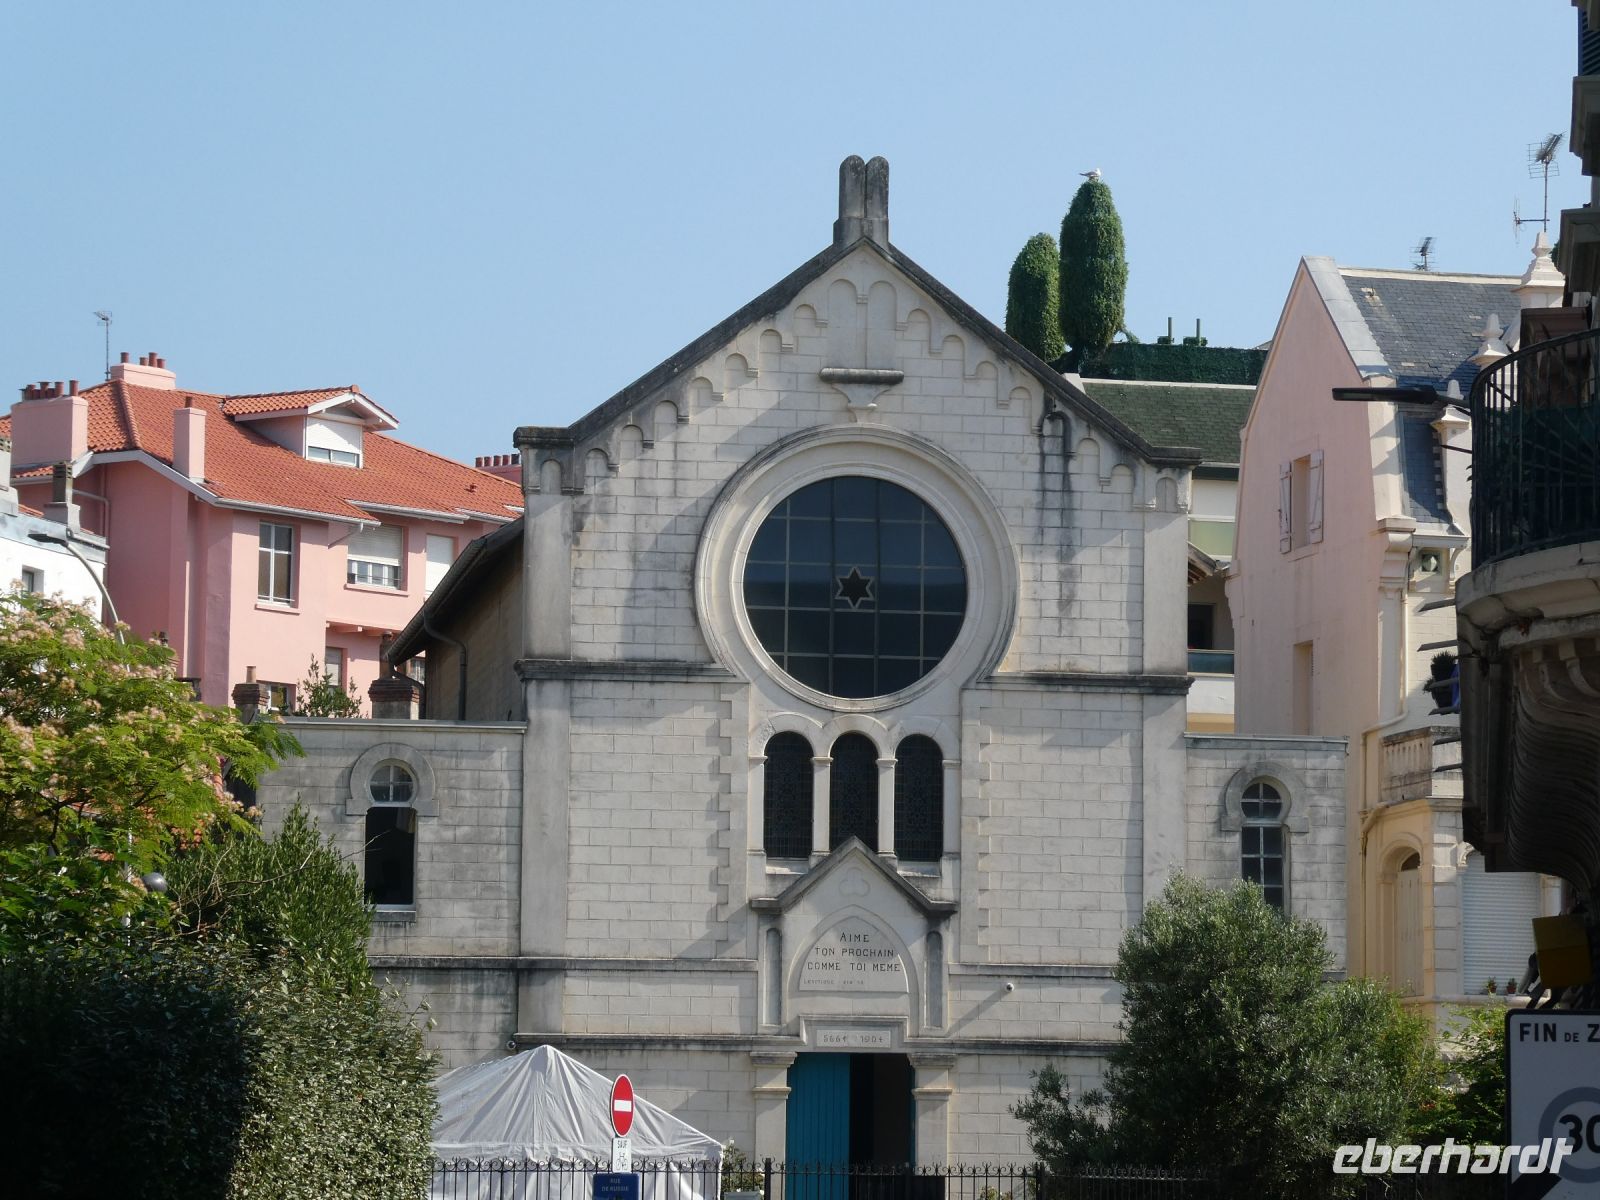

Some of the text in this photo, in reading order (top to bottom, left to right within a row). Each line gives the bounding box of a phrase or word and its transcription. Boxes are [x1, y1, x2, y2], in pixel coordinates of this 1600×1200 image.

[840, 932, 870, 943] AIME
[815, 947, 894, 957] TON PROCHAIN
[807, 962, 840, 971] COMME
[850, 962, 866, 971] TOI
[1519, 1023, 1557, 1042] FIN
[1564, 1032, 1580, 1042] DE
